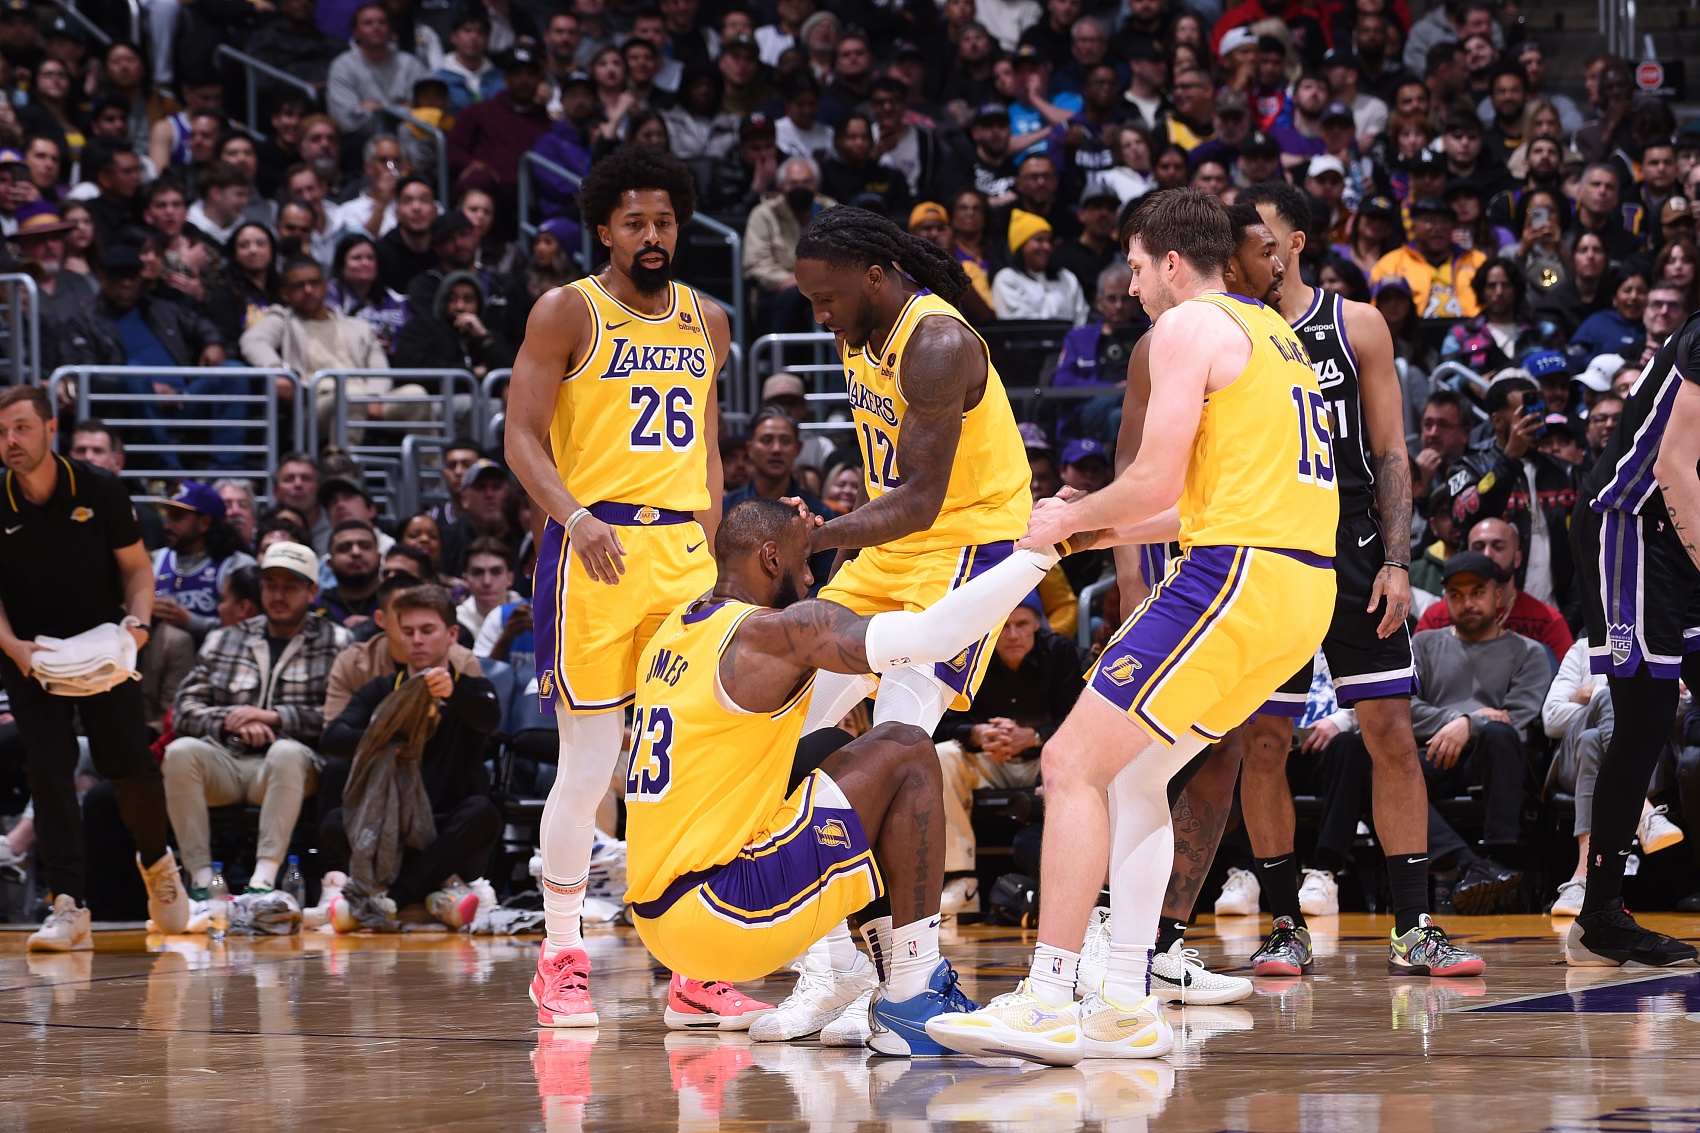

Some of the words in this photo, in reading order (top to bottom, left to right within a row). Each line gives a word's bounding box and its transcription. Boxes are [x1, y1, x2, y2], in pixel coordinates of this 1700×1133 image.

[598, 338, 708, 380] LAKERS
[677, 322, 701, 334] bibigo
[1303, 323, 1335, 333] dialpad
[629, 385, 697, 452] 26
[1290, 384, 1337, 491] 15
[862, 421, 900, 493] 12
[624, 705, 675, 803] 23
